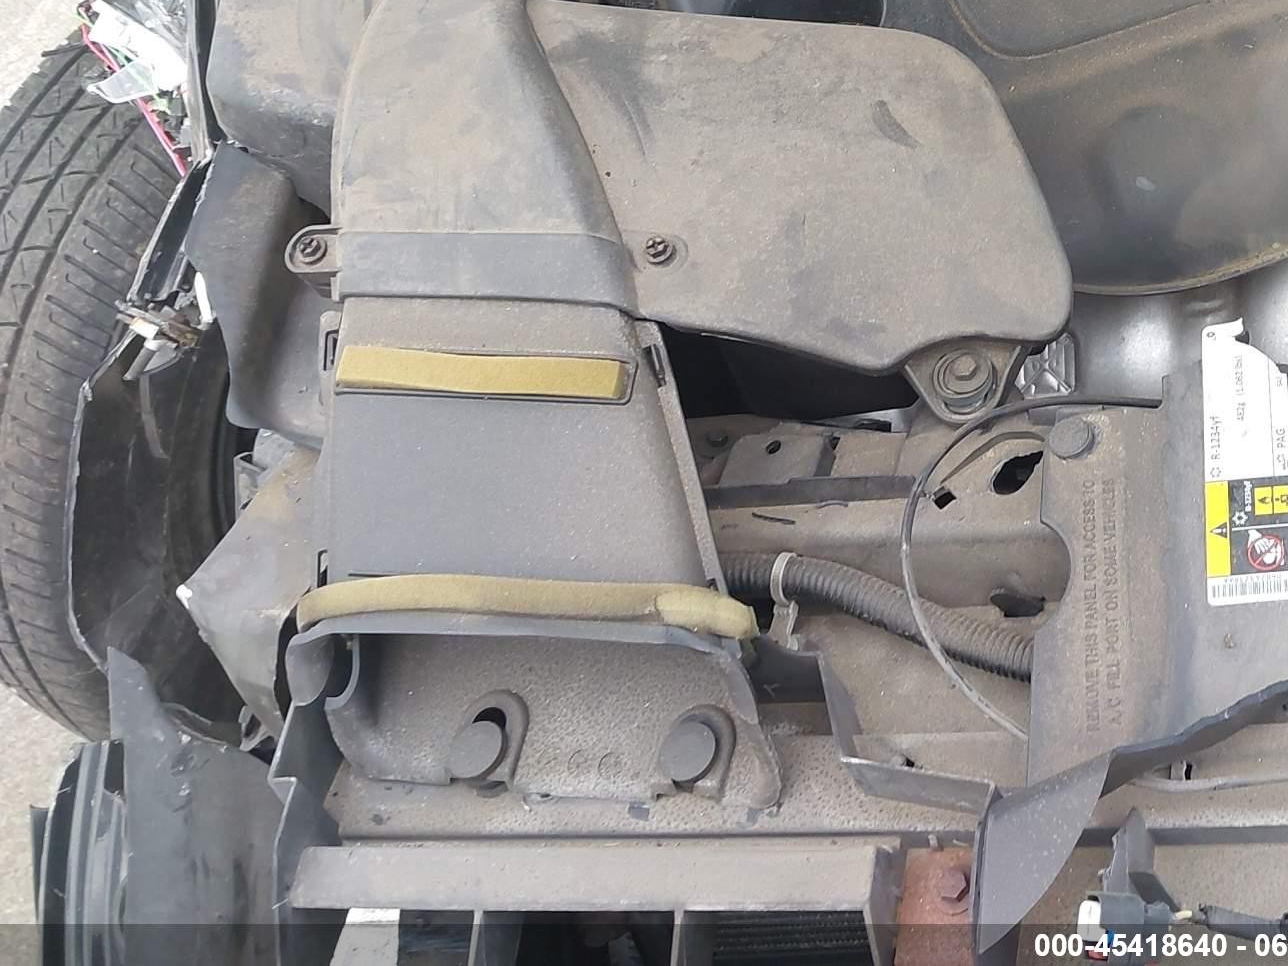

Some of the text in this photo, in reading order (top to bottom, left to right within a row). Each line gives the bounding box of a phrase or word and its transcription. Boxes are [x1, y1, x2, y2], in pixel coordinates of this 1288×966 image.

[1276, 428, 1286, 449] PAG
[1101, 478, 1117, 544] VEHICLES
[1102, 545, 1118, 587] SOME
[1082, 480, 1100, 734] REMOVE THIS PANEL FOR ACCESS TO
[1103, 589, 1118, 611] ON
[1104, 617, 1119, 654] PORT
[1105, 659, 1120, 690] FILL
